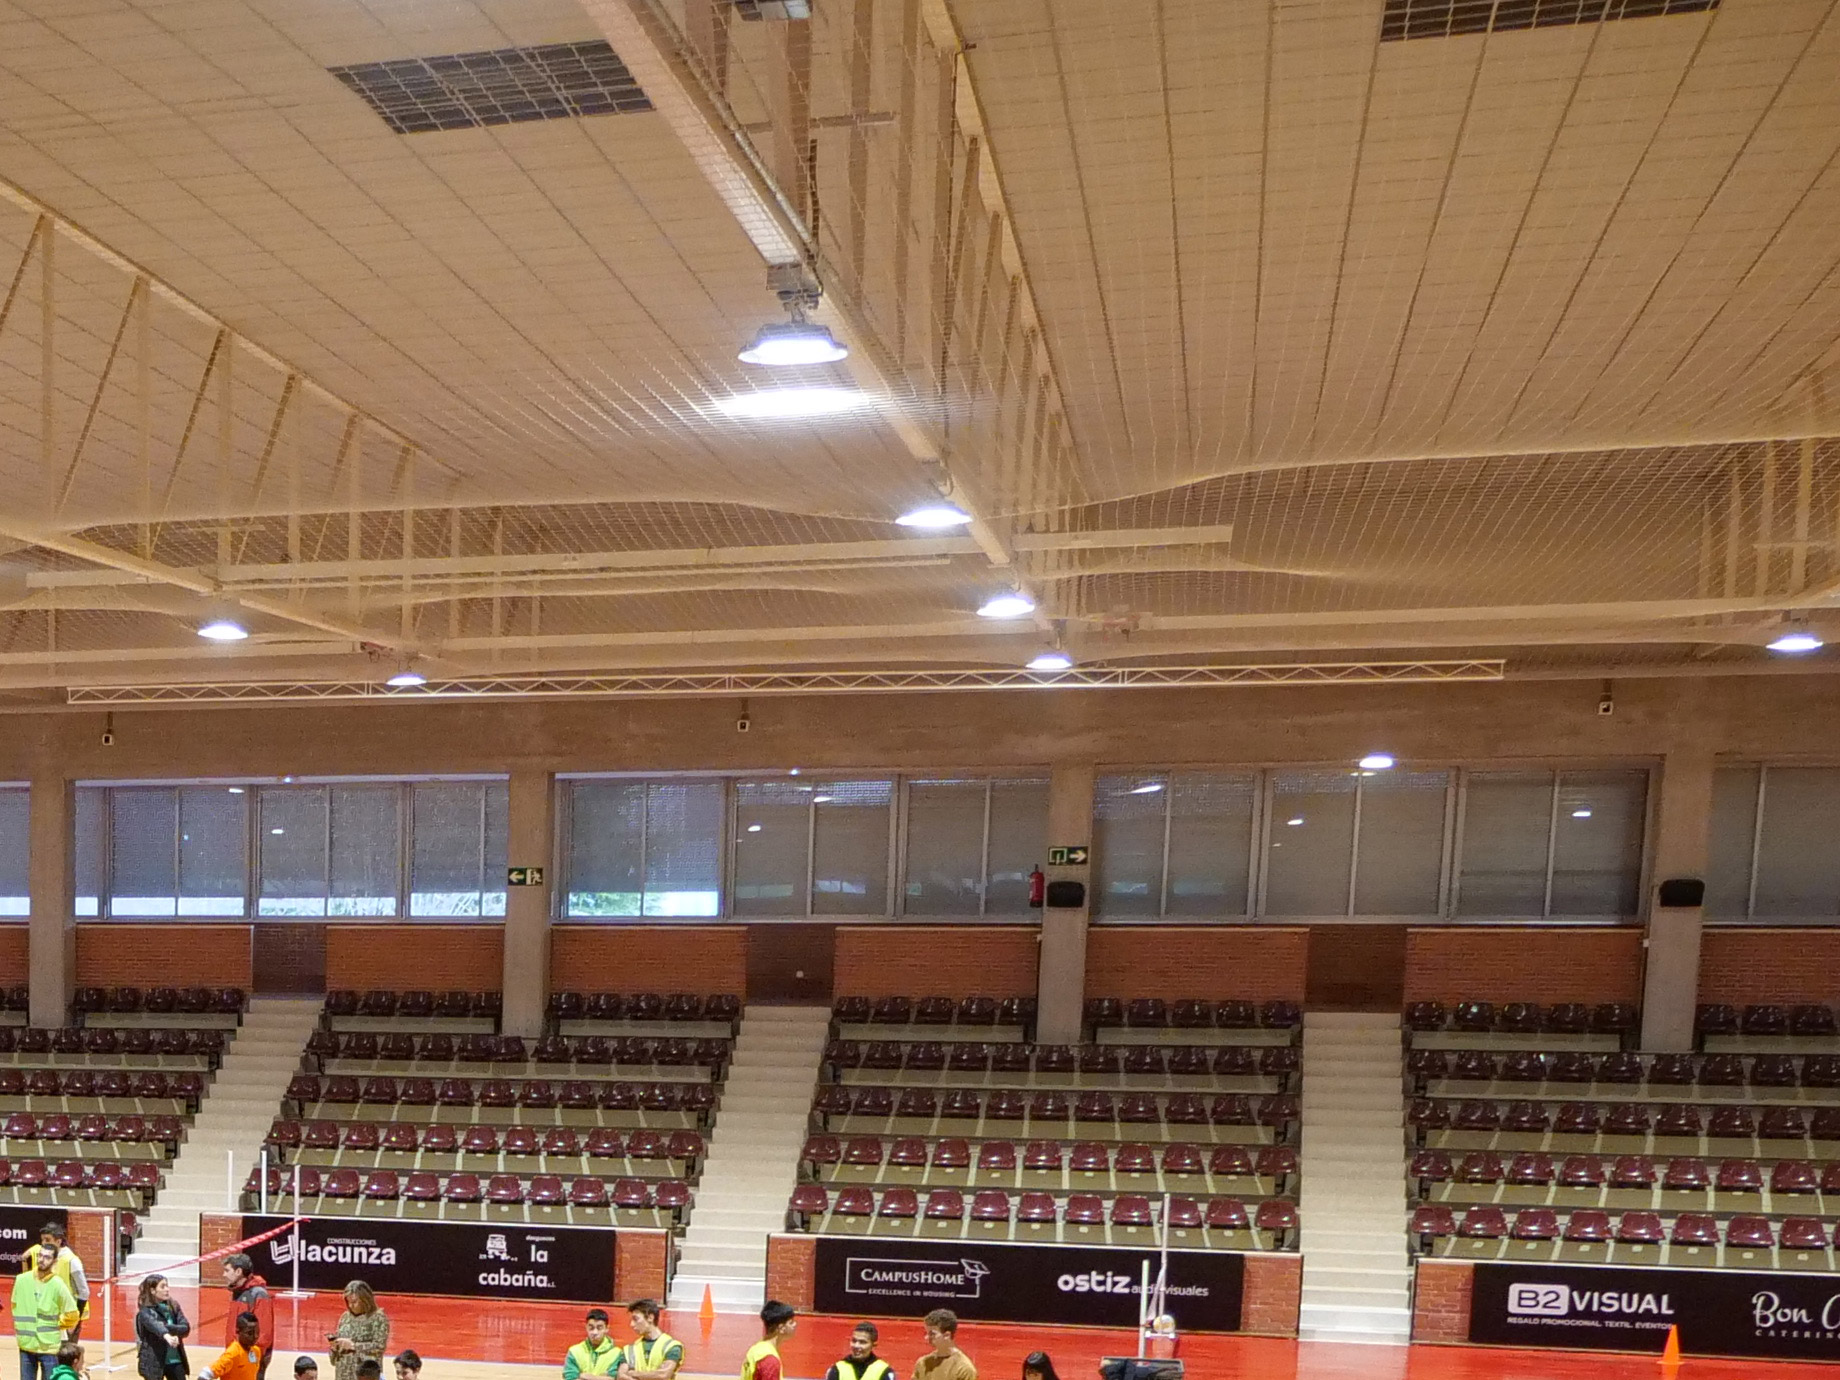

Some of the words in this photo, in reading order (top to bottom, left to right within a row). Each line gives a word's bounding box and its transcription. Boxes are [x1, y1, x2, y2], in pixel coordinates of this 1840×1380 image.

[300, 1240, 396, 1265] lacunza
[531, 1244, 548, 1262] la
[479, 1268, 548, 1288] cabaña
[1057, 1270, 1131, 1293] ostiz
[868, 1288, 912, 1296] EXCELLENCE
[1517, 1289, 1562, 1309] B2
[1572, 1291, 1675, 1315] VISUAL
[1752, 1291, 1814, 1328] Bon
[1507, 1317, 1540, 1325] REGALO
